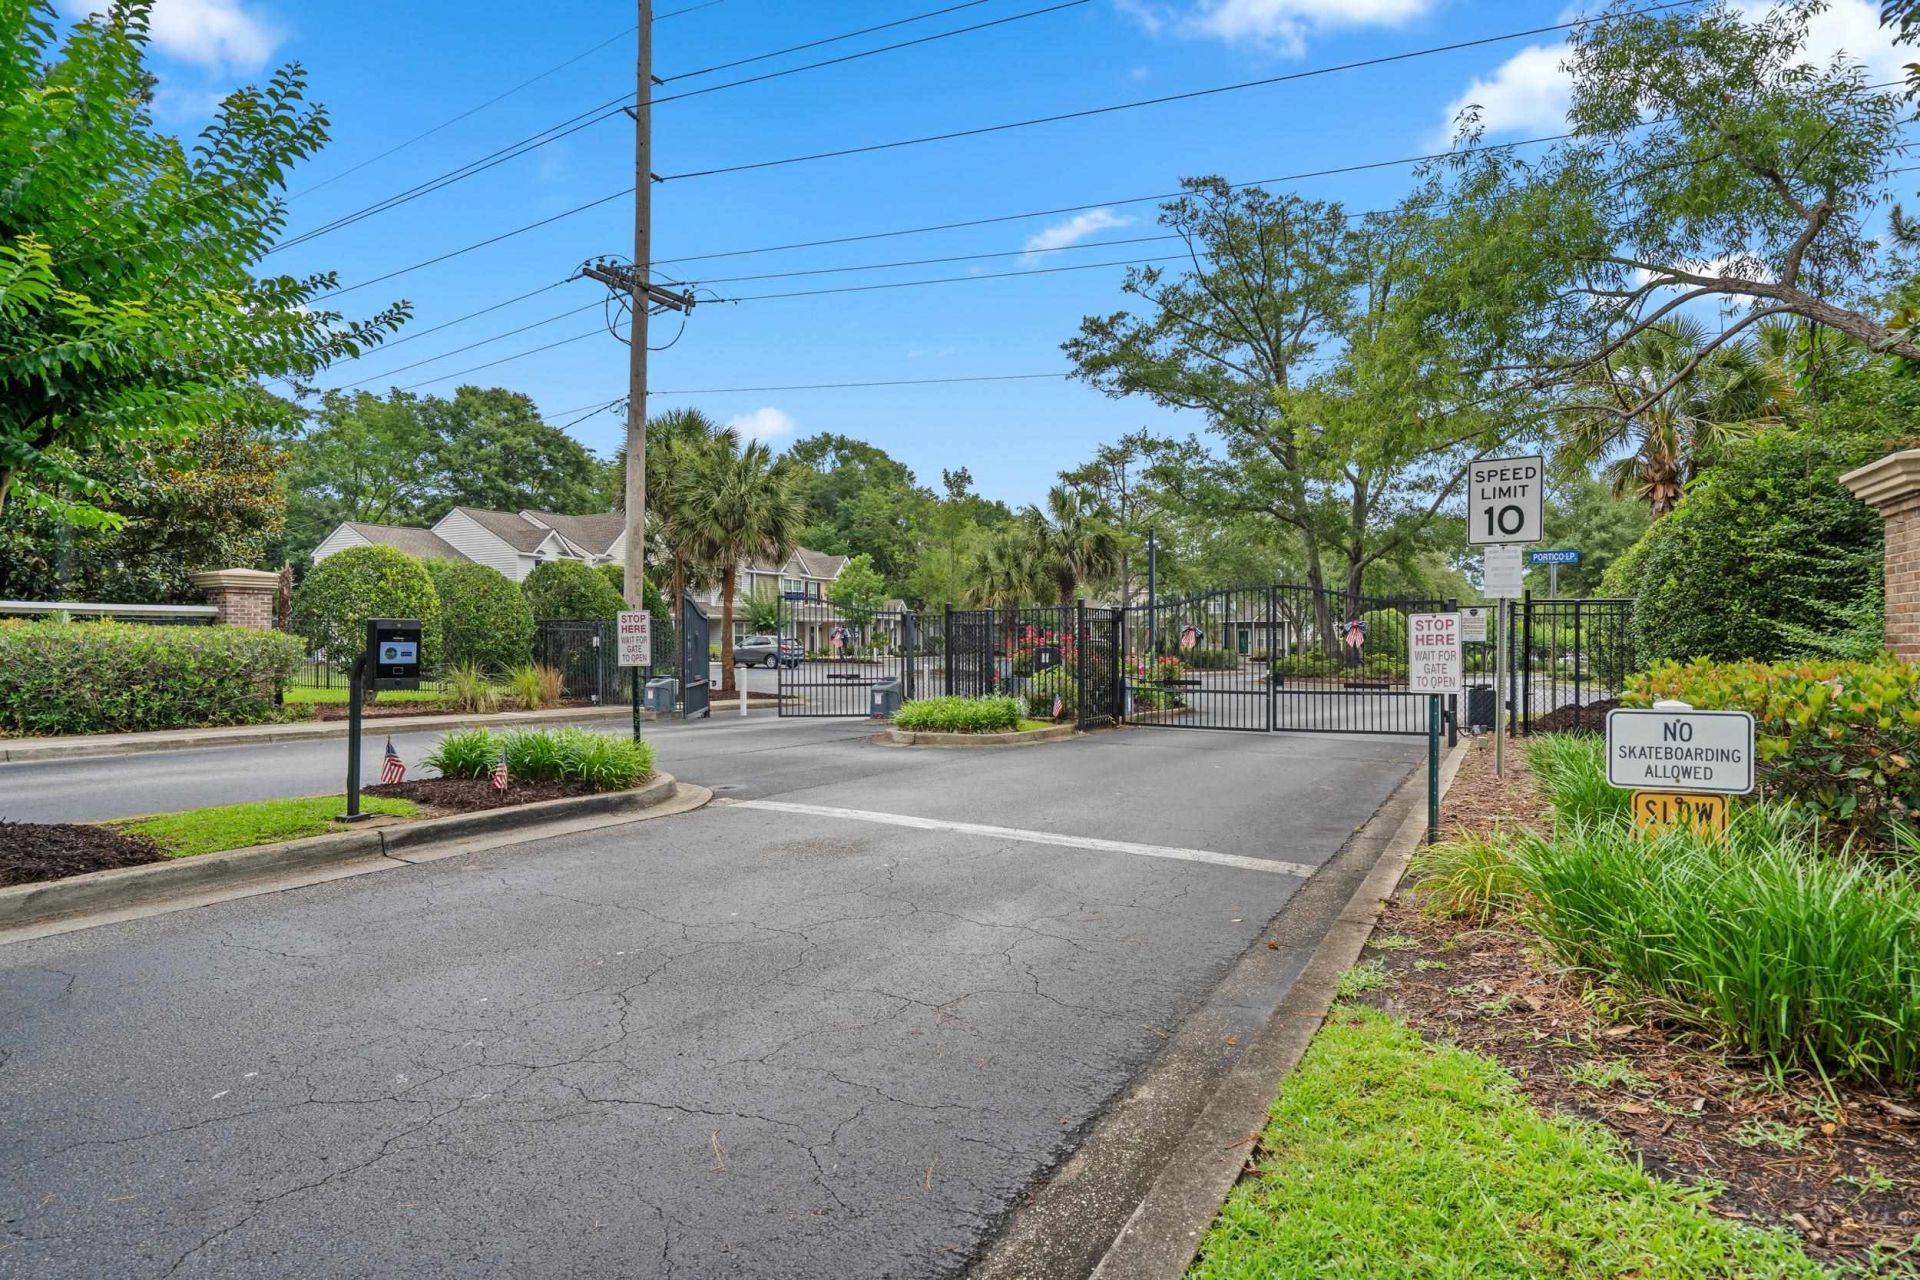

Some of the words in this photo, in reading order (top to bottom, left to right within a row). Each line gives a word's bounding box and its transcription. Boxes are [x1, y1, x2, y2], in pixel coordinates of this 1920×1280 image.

[1475, 466, 1537, 483] SPEED
[1481, 484, 1529, 500] LIMIT
[1484, 504, 1525, 536] 10
[1532, 552, 1564, 562] PORTICO
[621, 614, 647, 623] STOP
[621, 624, 647, 634] HERE
[1415, 619, 1454, 632] STOP
[621, 636, 635, 645] WAIT
[636, 635, 647, 644] FOR
[1415, 634, 1455, 646] HERE
[626, 645, 642, 653] GATE
[622, 654, 630, 662] TO
[631, 653, 647, 662] OPEN
[1414, 650, 1437, 661] WAIT
[1438, 650, 1457, 661] FOR
[1423, 663, 1448, 674] GATE
[1416, 676, 1429, 687] TO
[1430, 676, 1456, 688] OPEN
[1663, 722, 1693, 742] NO
[1618, 745, 1741, 763] SKATEBOARDING
[1644, 764, 1713, 780] ALLOWED
[1645, 800, 1713, 826] SLOW
